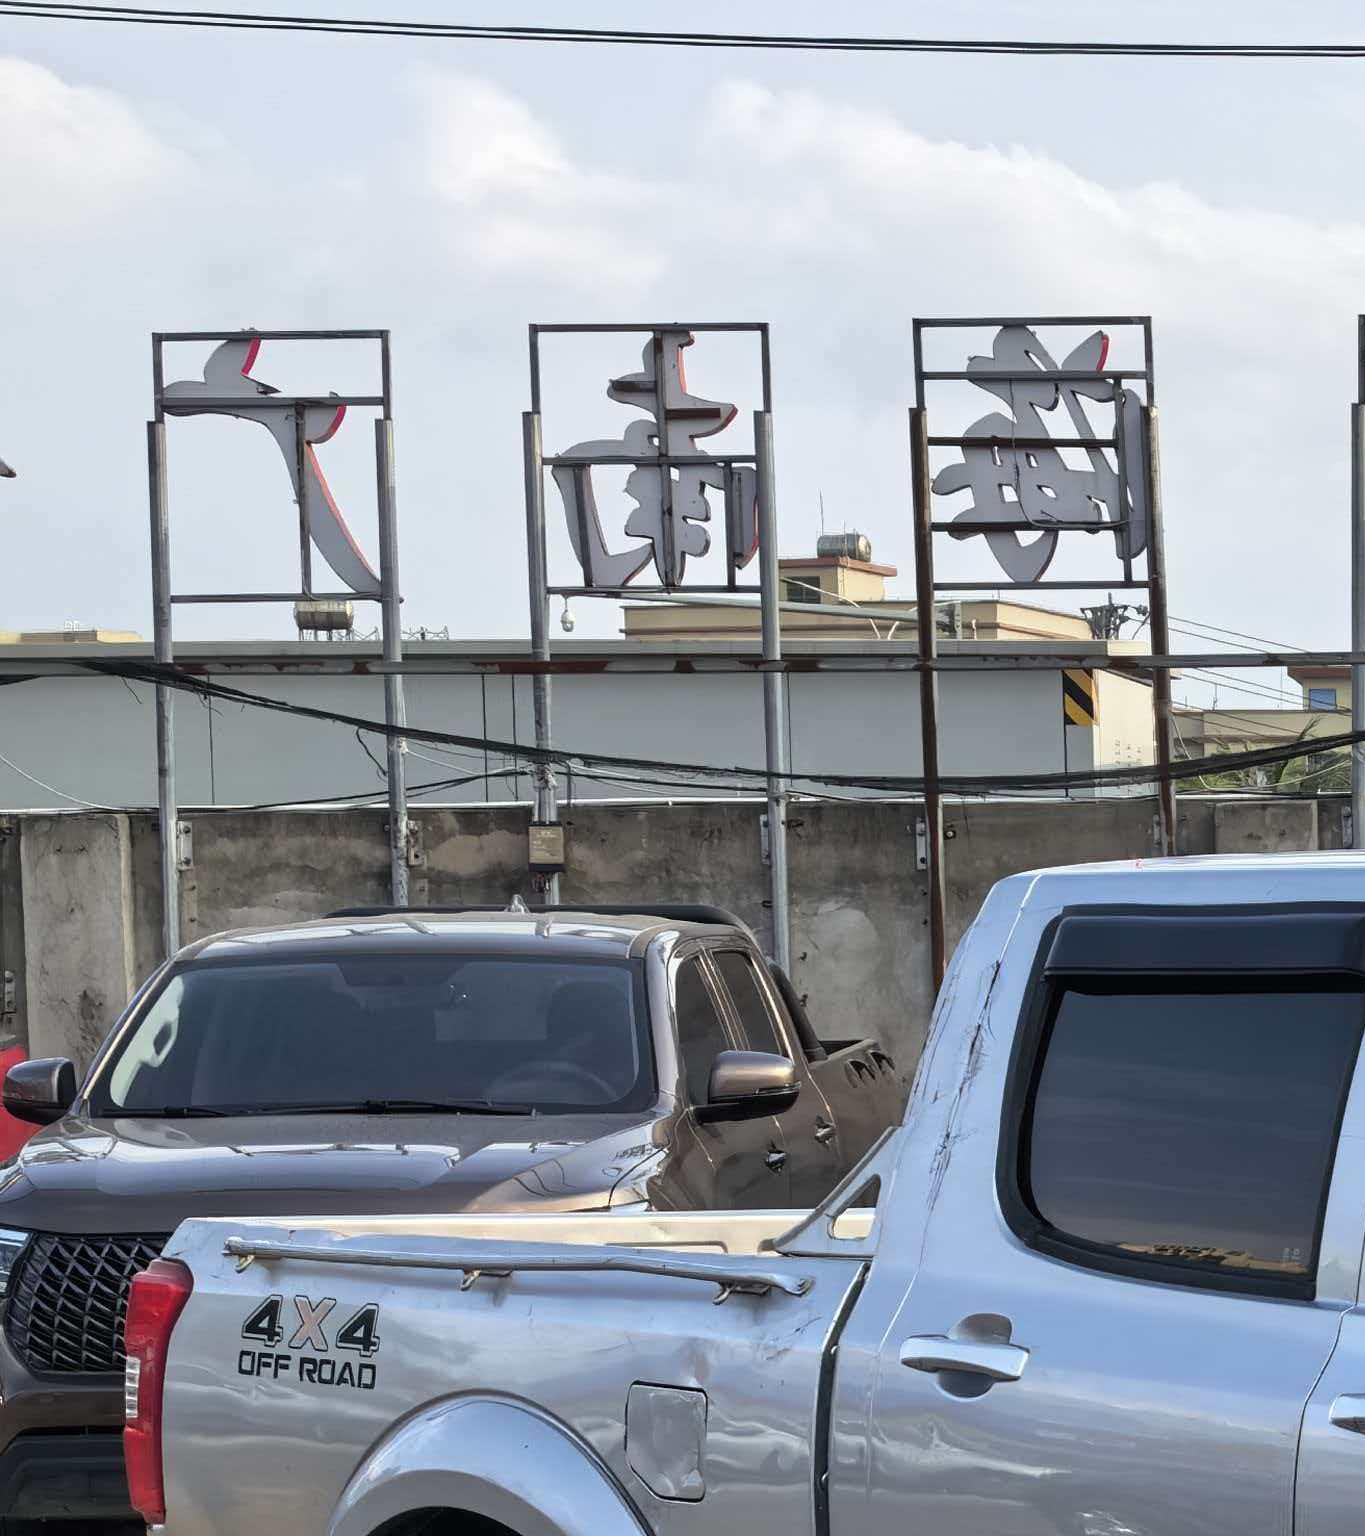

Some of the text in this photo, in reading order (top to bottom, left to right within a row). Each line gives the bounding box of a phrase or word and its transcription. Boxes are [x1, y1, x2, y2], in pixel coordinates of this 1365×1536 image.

[241, 1294, 381, 1358] 4X4
[238, 1350, 377, 1390] OFF ROAD
